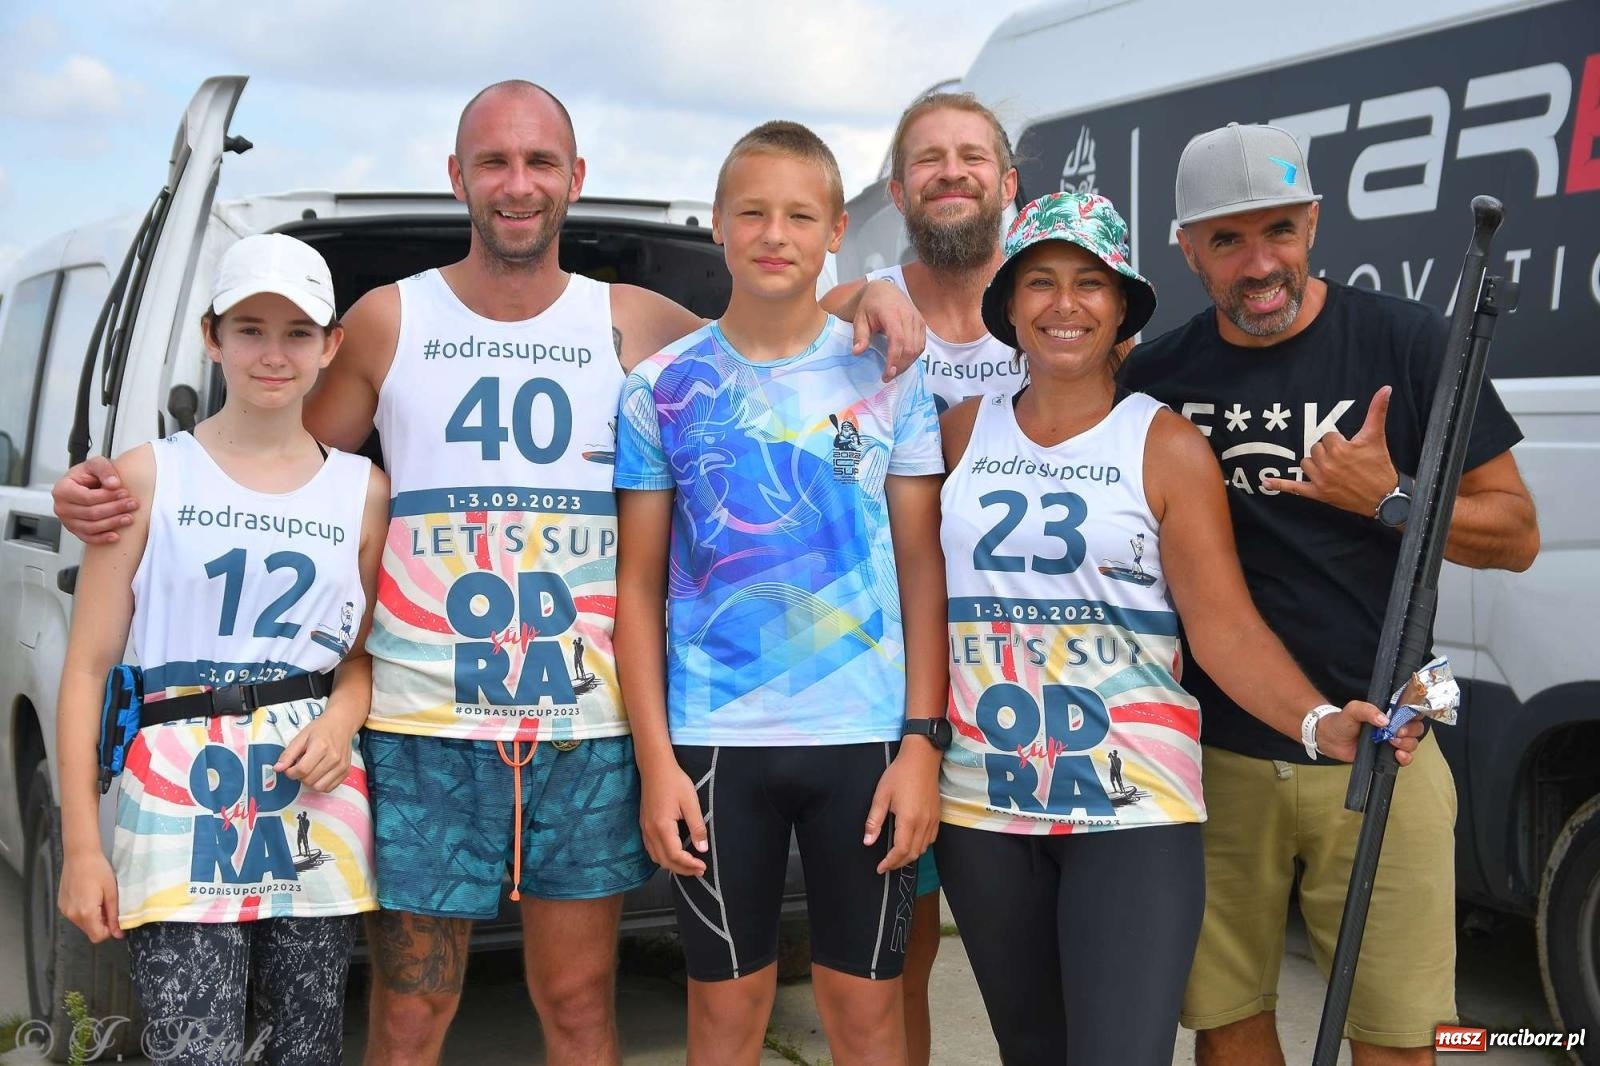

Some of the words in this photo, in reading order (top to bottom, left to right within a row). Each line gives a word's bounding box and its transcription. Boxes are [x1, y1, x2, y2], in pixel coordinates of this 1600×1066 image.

[424, 336, 592, 368] #odrasupcup
[445, 376, 573, 465] 40
[971, 456, 1121, 486] #odrasupcup
[447, 493, 582, 510] 1-3.09.2023
[178, 505, 345, 546] #odrasupcup
[411, 525, 525, 557] LET'S
[542, 524, 616, 558] SUP
[973, 489, 1088, 575] 23
[204, 547, 316, 640] 12
[974, 603, 1105, 621] 1-3.09.2023
[950, 636, 1048, 666] LET'S
[1066, 636, 1143, 666] SUP
[455, 706, 581, 718] #ODRASUPCUP2023
